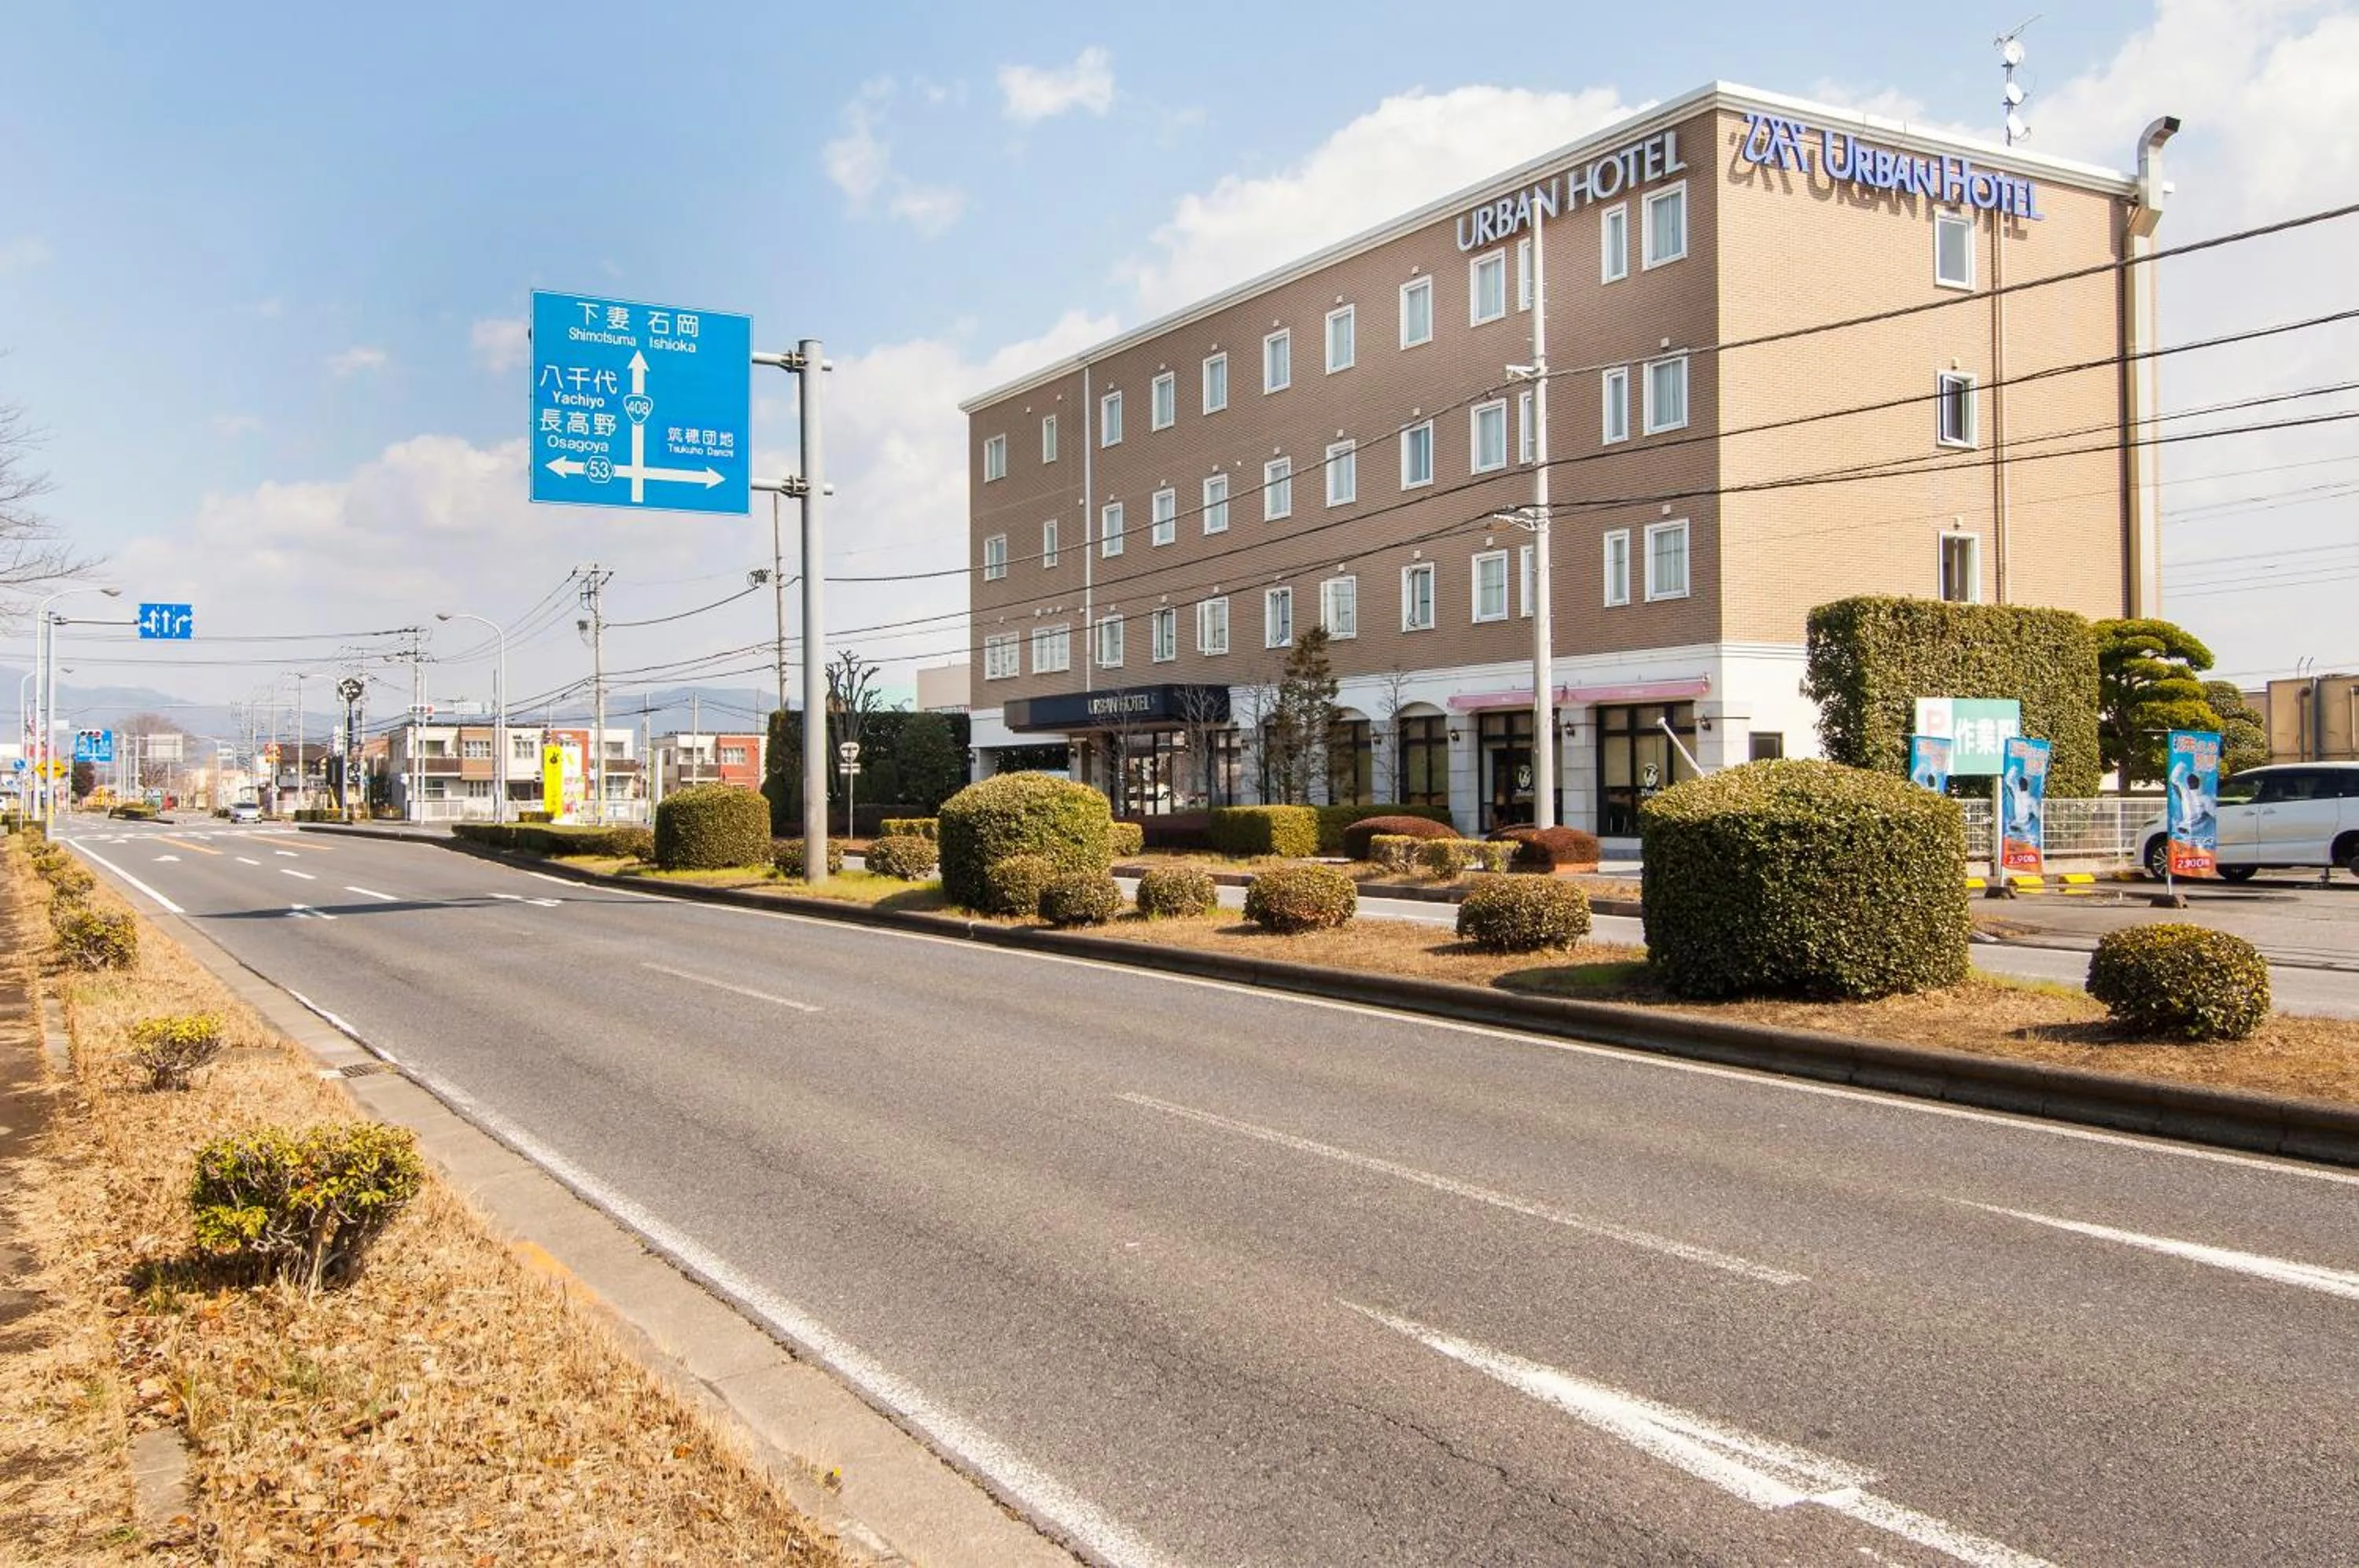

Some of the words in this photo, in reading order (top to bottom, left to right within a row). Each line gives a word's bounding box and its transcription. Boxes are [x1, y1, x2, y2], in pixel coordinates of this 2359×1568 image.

[1823, 130, 1934, 197] URBAN
[1939, 155, 2044, 220] HOTEL
[1456, 178, 1560, 252] URBAN
[1568, 131, 1687, 212] HOTEL
[576, 302, 629, 330] 下妻
[648, 311, 698, 337] 石岡
[569, 327, 636, 347] Shimotsuma
[649, 337, 696, 353] Ishioka
[539, 364, 617, 395] 八千代
[553, 391, 605, 409] Yachiyo
[628, 401, 649, 414] 408
[539, 408, 616, 436] 長高野
[547, 435, 609, 453] Osagoya
[589, 461, 609, 478] 53
